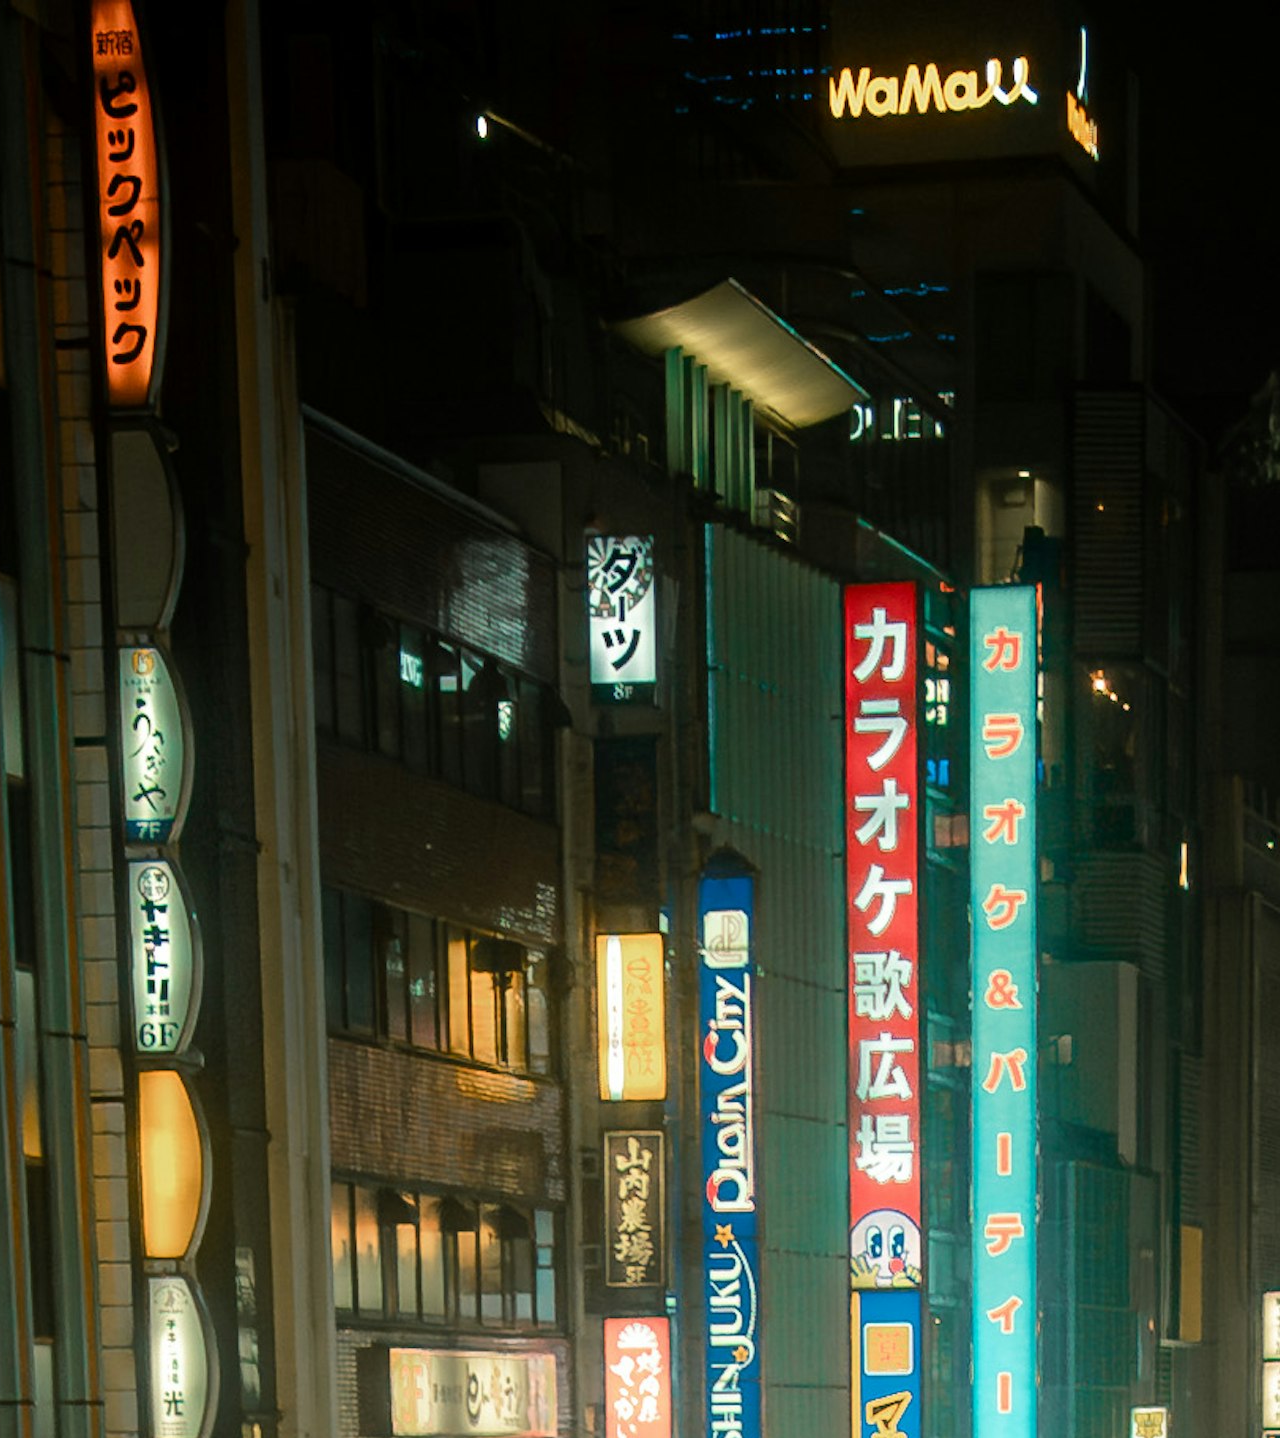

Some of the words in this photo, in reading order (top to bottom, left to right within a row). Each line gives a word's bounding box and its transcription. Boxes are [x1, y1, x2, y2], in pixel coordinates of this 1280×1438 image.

[602, 548, 641, 671] ダーツ
[137, 821, 161, 839] 7F
[852, 607, 916, 1187] カラオケ歌広場
[139, 1022, 178, 1048] 6F
[614, 1136, 655, 1267] 山内農場
